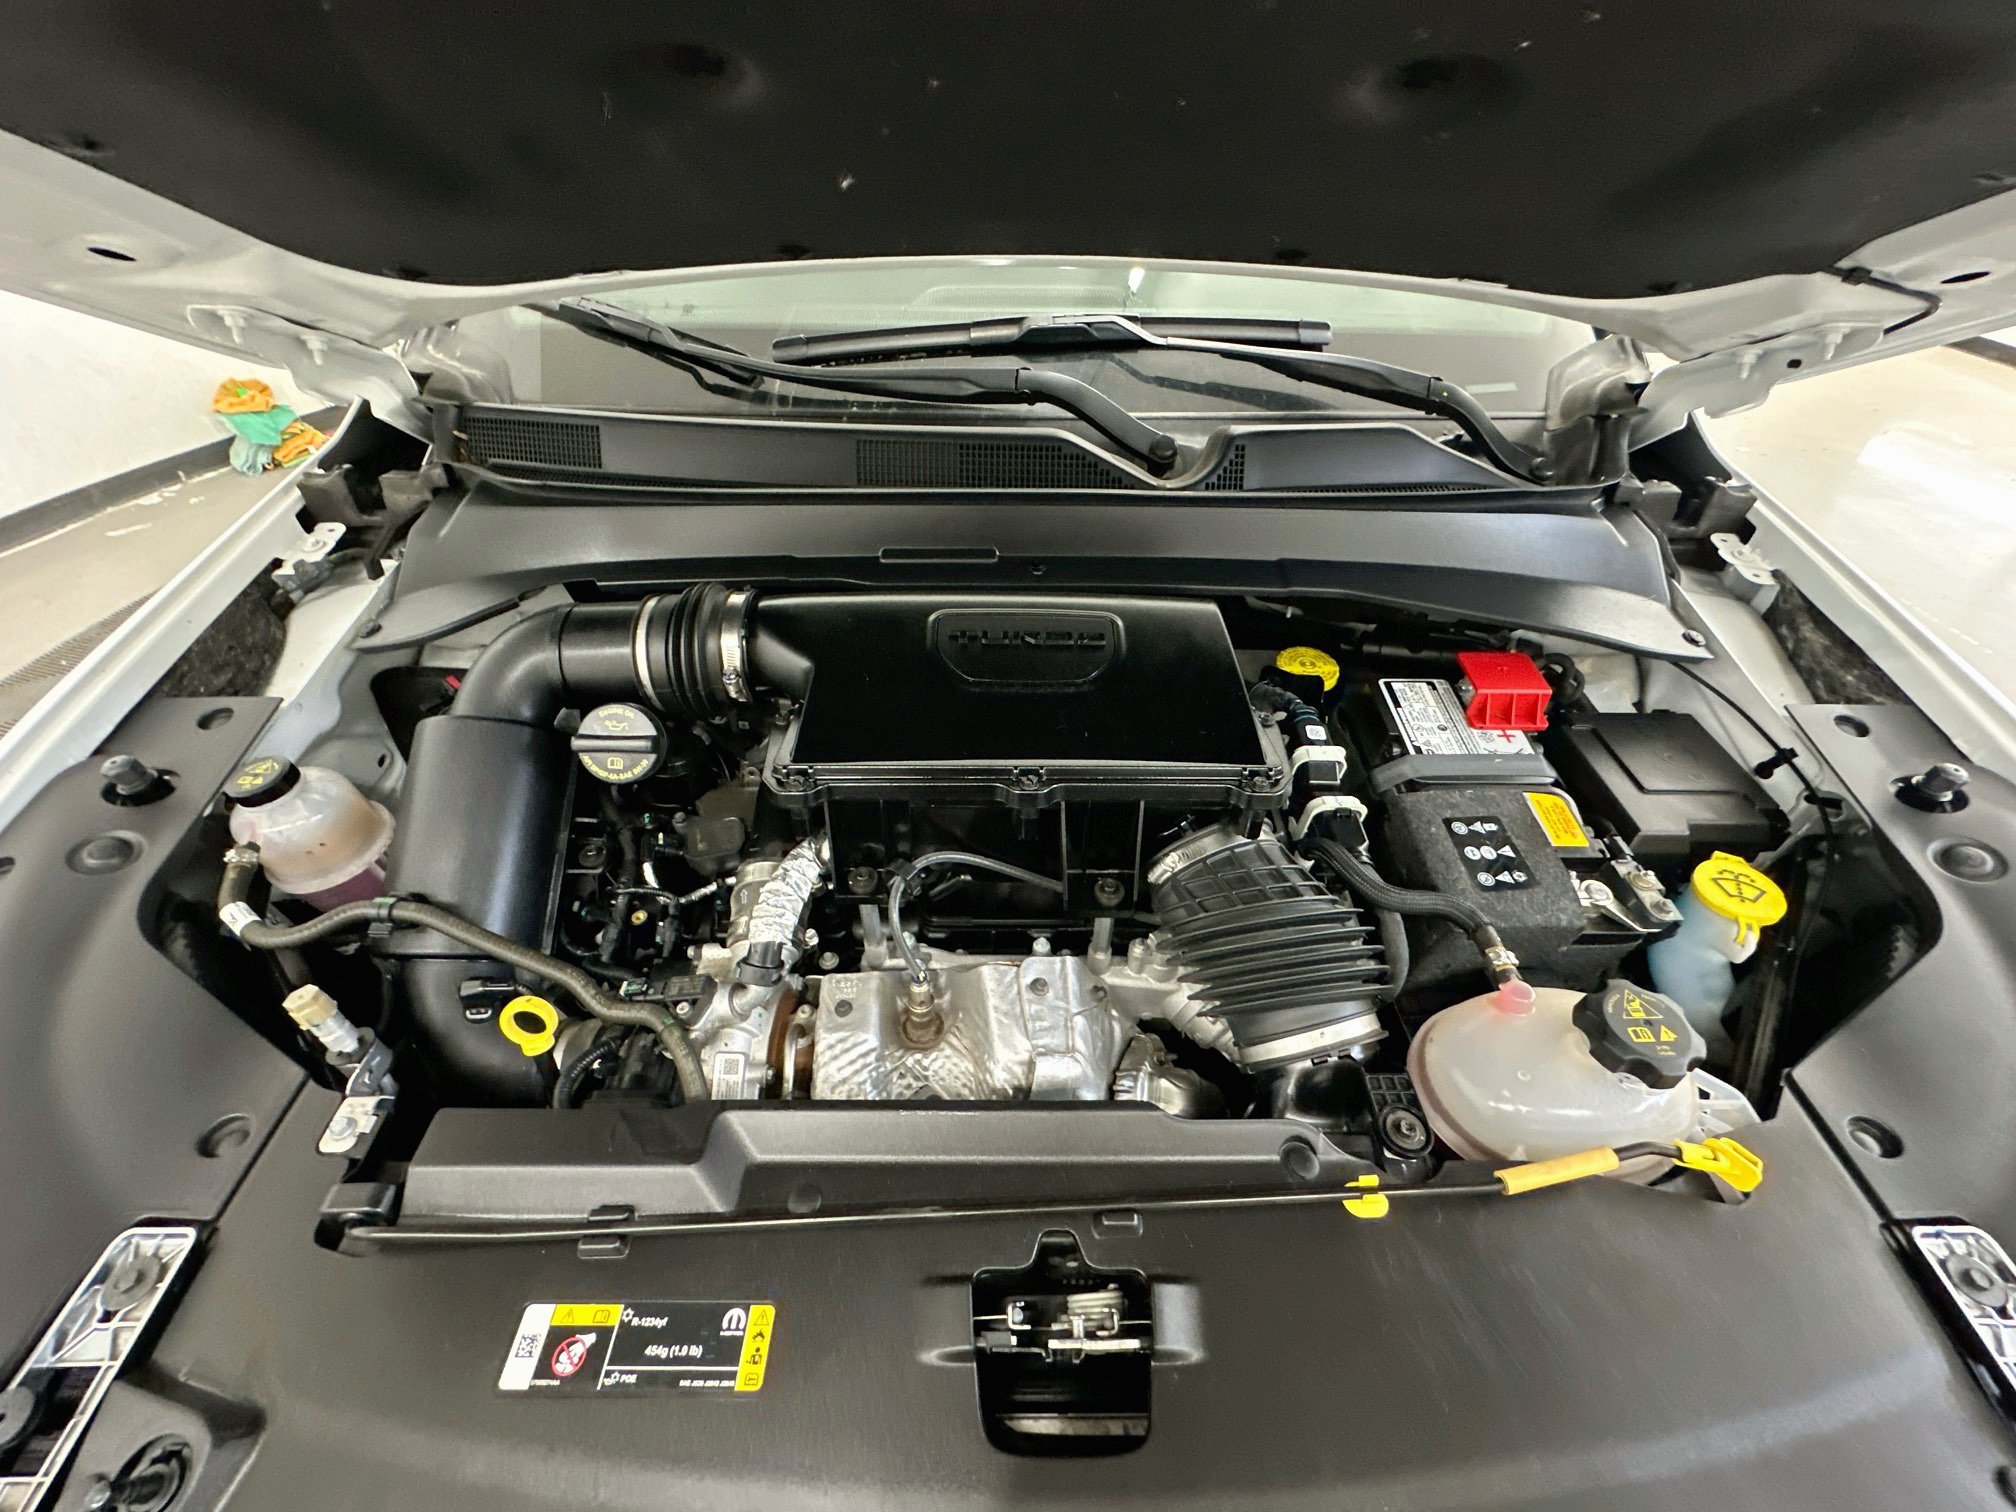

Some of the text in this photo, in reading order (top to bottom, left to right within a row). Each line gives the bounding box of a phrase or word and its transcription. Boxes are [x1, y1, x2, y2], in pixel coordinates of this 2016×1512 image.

[631, 1316, 668, 1328] R-1234yf
[644, 1345, 668, 1357] 454g
[620, 1373, 637, 1384] POE
